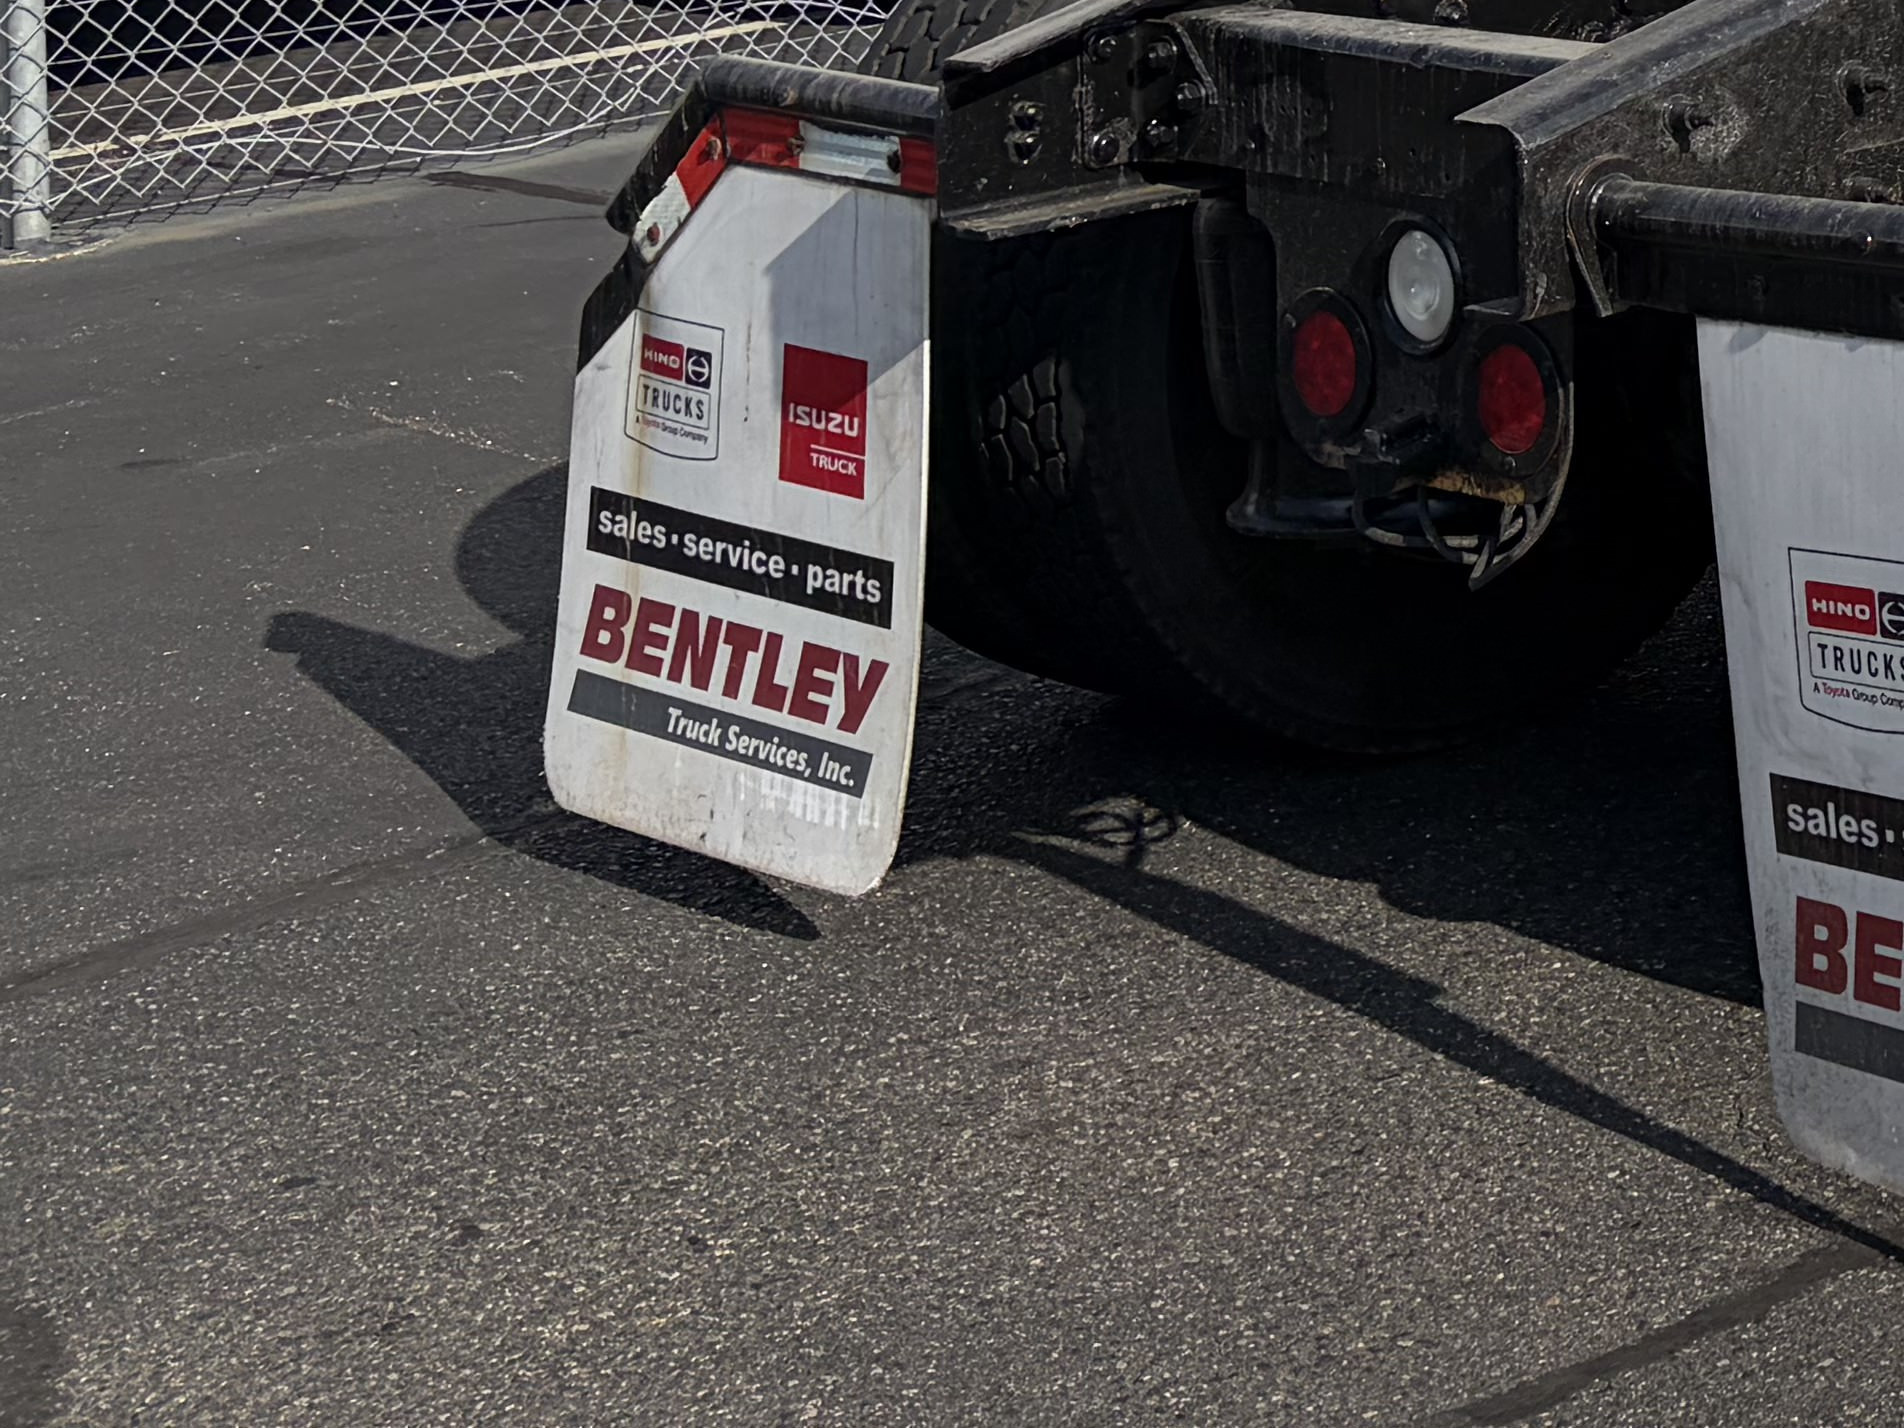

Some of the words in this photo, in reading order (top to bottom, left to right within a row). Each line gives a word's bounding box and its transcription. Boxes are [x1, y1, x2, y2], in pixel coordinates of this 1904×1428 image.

[643, 348, 681, 370] HINO
[642, 384, 705, 421] TRUCKS
[788, 402, 859, 438] ISUZU
[809, 451, 857, 477] TRUCK
[597, 509, 667, 549] sales
[683, 532, 786, 579] service
[805, 563, 882, 604] parts
[1811, 597, 1872, 621] HINO
[579, 583, 890, 735] BENTLEY
[1813, 681, 1821, 694] A
[1821, 681, 1851, 700] Toyota
[1851, 688, 1879, 706] Group
[666, 706, 720, 747] Truck
[725, 725, 812, 778] Services,
[817, 751, 855, 787] Inc.
[1786, 801, 1880, 848] sales
